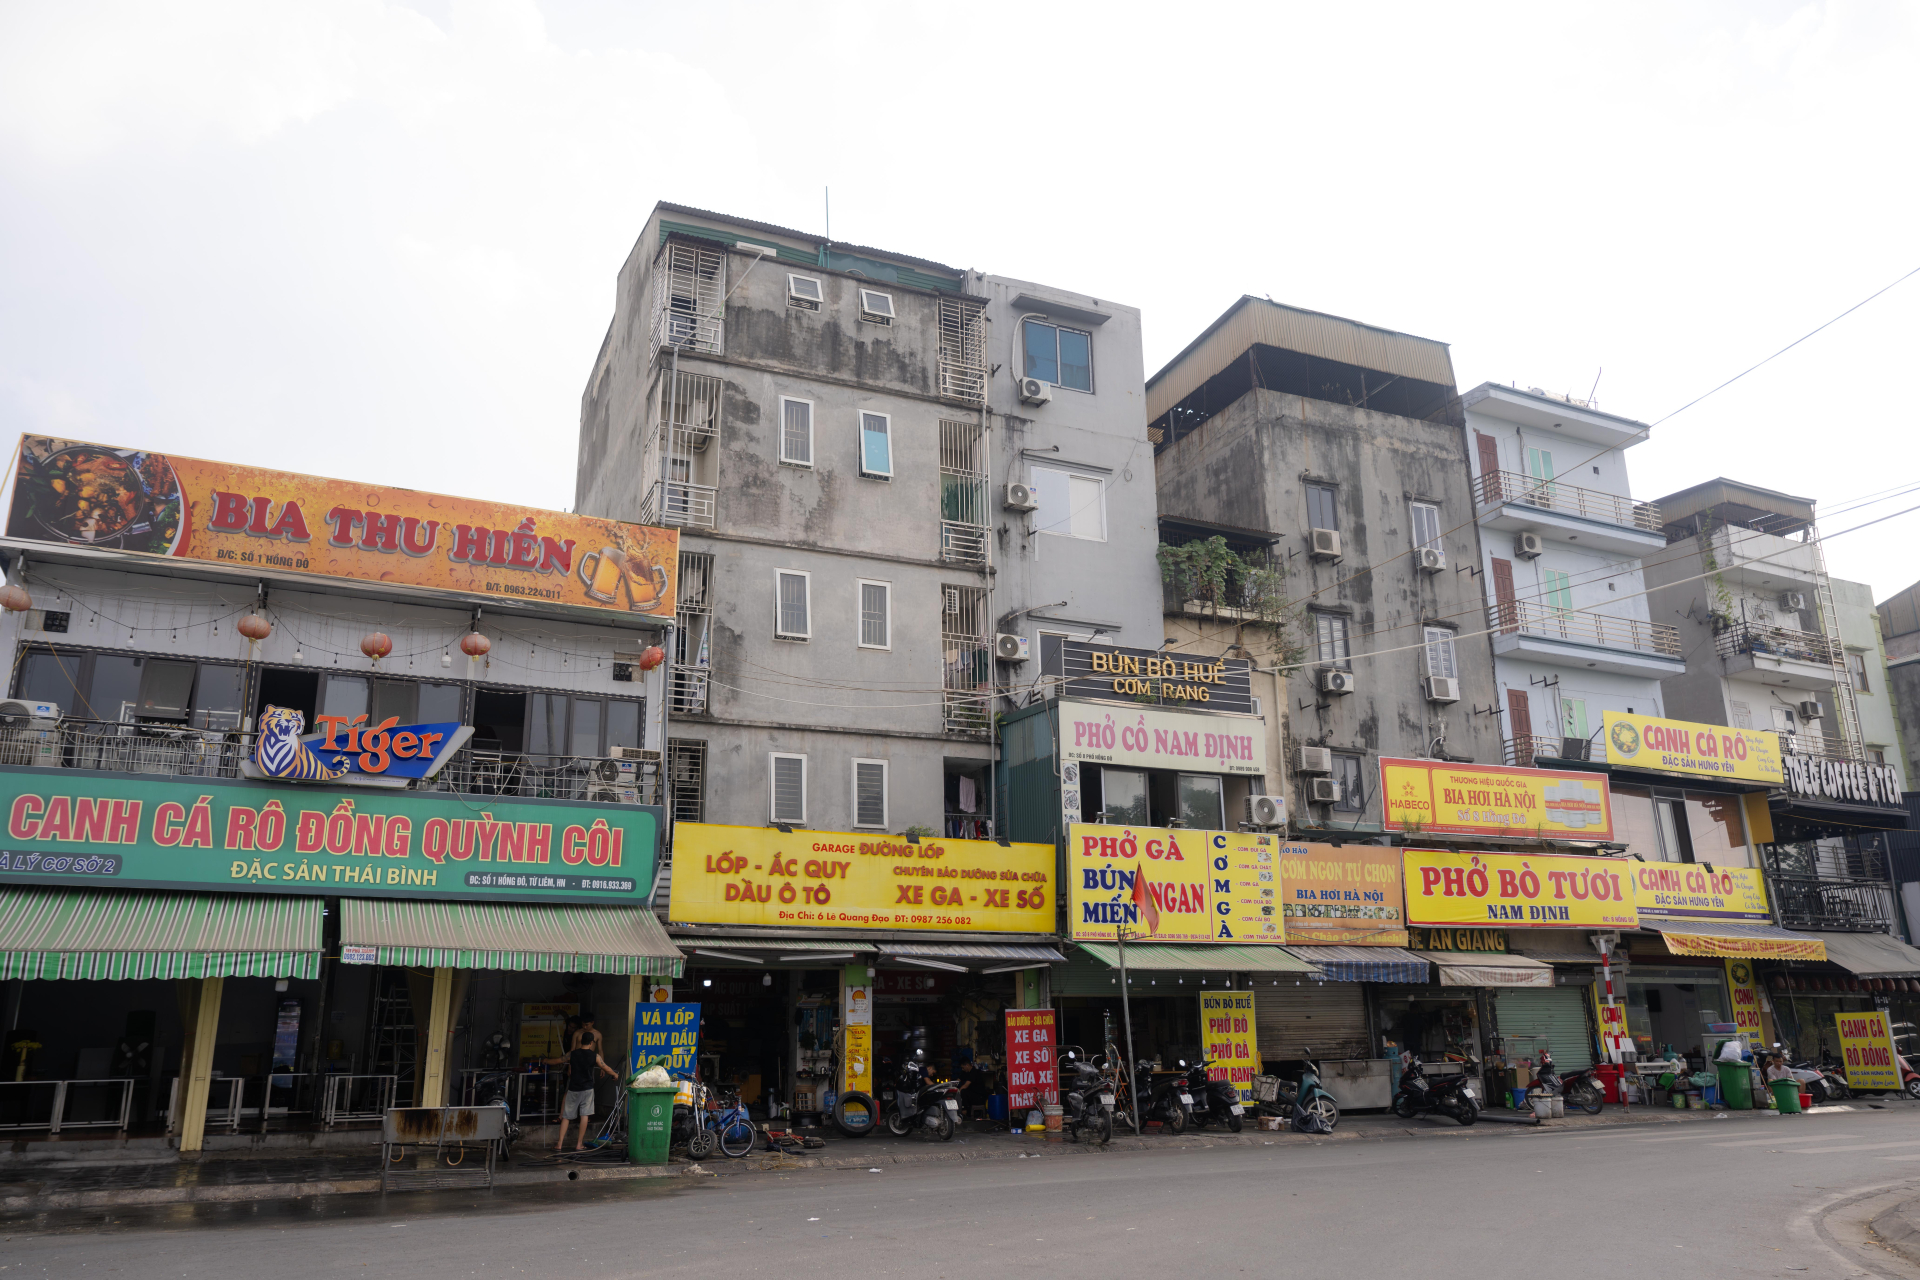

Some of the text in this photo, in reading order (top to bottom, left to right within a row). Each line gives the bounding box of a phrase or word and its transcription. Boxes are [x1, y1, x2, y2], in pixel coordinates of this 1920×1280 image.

[208, 491, 576, 577] BIA THU HIỀN
[217, 549, 309, 569] Đ/C: SỐ 1 HỒNG ĐÔ
[486, 582, 561, 600] Đ/T: 0963.224.011
[1091, 650, 1227, 685] BÚN BÒ HUẾ
[1113, 678, 1210, 702] CƠM RANG
[315, 714, 443, 773] Tiger
[1073, 713, 1254, 766] PHỞ CỒ NAM ĐỊNH
[1643, 724, 1747, 762] CANH CÁ RÔ
[1662, 755, 1735, 773] ĐẶC SẢN HƯNG YÊN
[1496, 777, 1515, 788] QUỐC
[1820, 759, 1903, 804] COFFEE & TEA
[1390, 799, 1430, 811] HABECO
[1443, 787, 1537, 813] BIA HƠI HÀ NỘI
[1457, 808, 1526, 826] Số 8 Hồng Đô
[8, 793, 624, 867] CANH CÁ RÔ ĐỒNG QUỲNH CÔI
[812, 840, 945, 859] GARAGE ĐƯỜNG LỐP
[1081, 829, 1185, 861] PHỞ GÀ
[12, 852, 116, 874] LÝ CƠ SỞ 2
[230, 857, 437, 886] ĐẶC SẢN THÁI BÌNH
[706, 850, 851, 879] LỐP ẮC QUY
[1281, 857, 1396, 888] CƠM NGON TỰ CHỌN
[469, 874, 591, 888] ĐC: SỐ HN ĐT:
[937, 866, 958, 878] BẢO
[961, 868, 997, 880] DƯỠNG
[1000, 869, 1019, 881] SỬA
[1021, 871, 1047, 882] CHỮA
[1082, 863, 1136, 891] BÚN
[1420, 856, 1623, 902] PHỞ BÒ TƯƠI
[1638, 867, 1734, 896] CANH CÁ RÔ
[725, 877, 831, 905] DẦU Ô TÔ
[895, 884, 1045, 909] XE GA XE SỐ
[1148, 881, 1205, 914] NGAN
[1296, 889, 1384, 904] BIA HƠI HÀ NỘI
[1655, 893, 1725, 908] ĐẶC SẢN HƯNG YÊN
[779, 910, 971, 925] Địa 6 Lê Quang Đạo ĐT: 0987 256 082
[1487, 904, 1570, 923] NAM ĐỊNH
[1429, 928, 1505, 951] AN GIANG
[1690, 936, 1702, 949] CÁ
[1704, 938, 1716, 951] RÔ
[1718, 938, 1740, 952] ĐỒNG
[1741, 940, 1757, 954] ĐẶC
[1759, 939, 1775, 953] SẢN
[1799, 941, 1815, 955] YÊN
[897, 976, 911, 990] XE
[1203, 993, 1252, 1009] BÚN BÒ HUẾ
[1734, 988, 1755, 1005] CANH
[642, 1006, 695, 1025] VÁ LỐP
[1209, 1012, 1248, 1034] PHỞ BÒ
[1736, 1006, 1760, 1027] CÁ RÔ
[636, 1027, 697, 1046] THAY DẦU
[1014, 1029, 1048, 1043] XE GA
[1840, 1014, 1885, 1039] CANH CÁ
[1015, 1051, 1030, 1064] XE
[1210, 1037, 1250, 1060] PHỞ GÀ
[1845, 1043, 1861, 1067] RÔ
[1012, 1068, 1054, 1085] RỬA XE
[1206, 1065, 1229, 1082] CƠM
[1010, 1091, 1034, 1107] THAY
